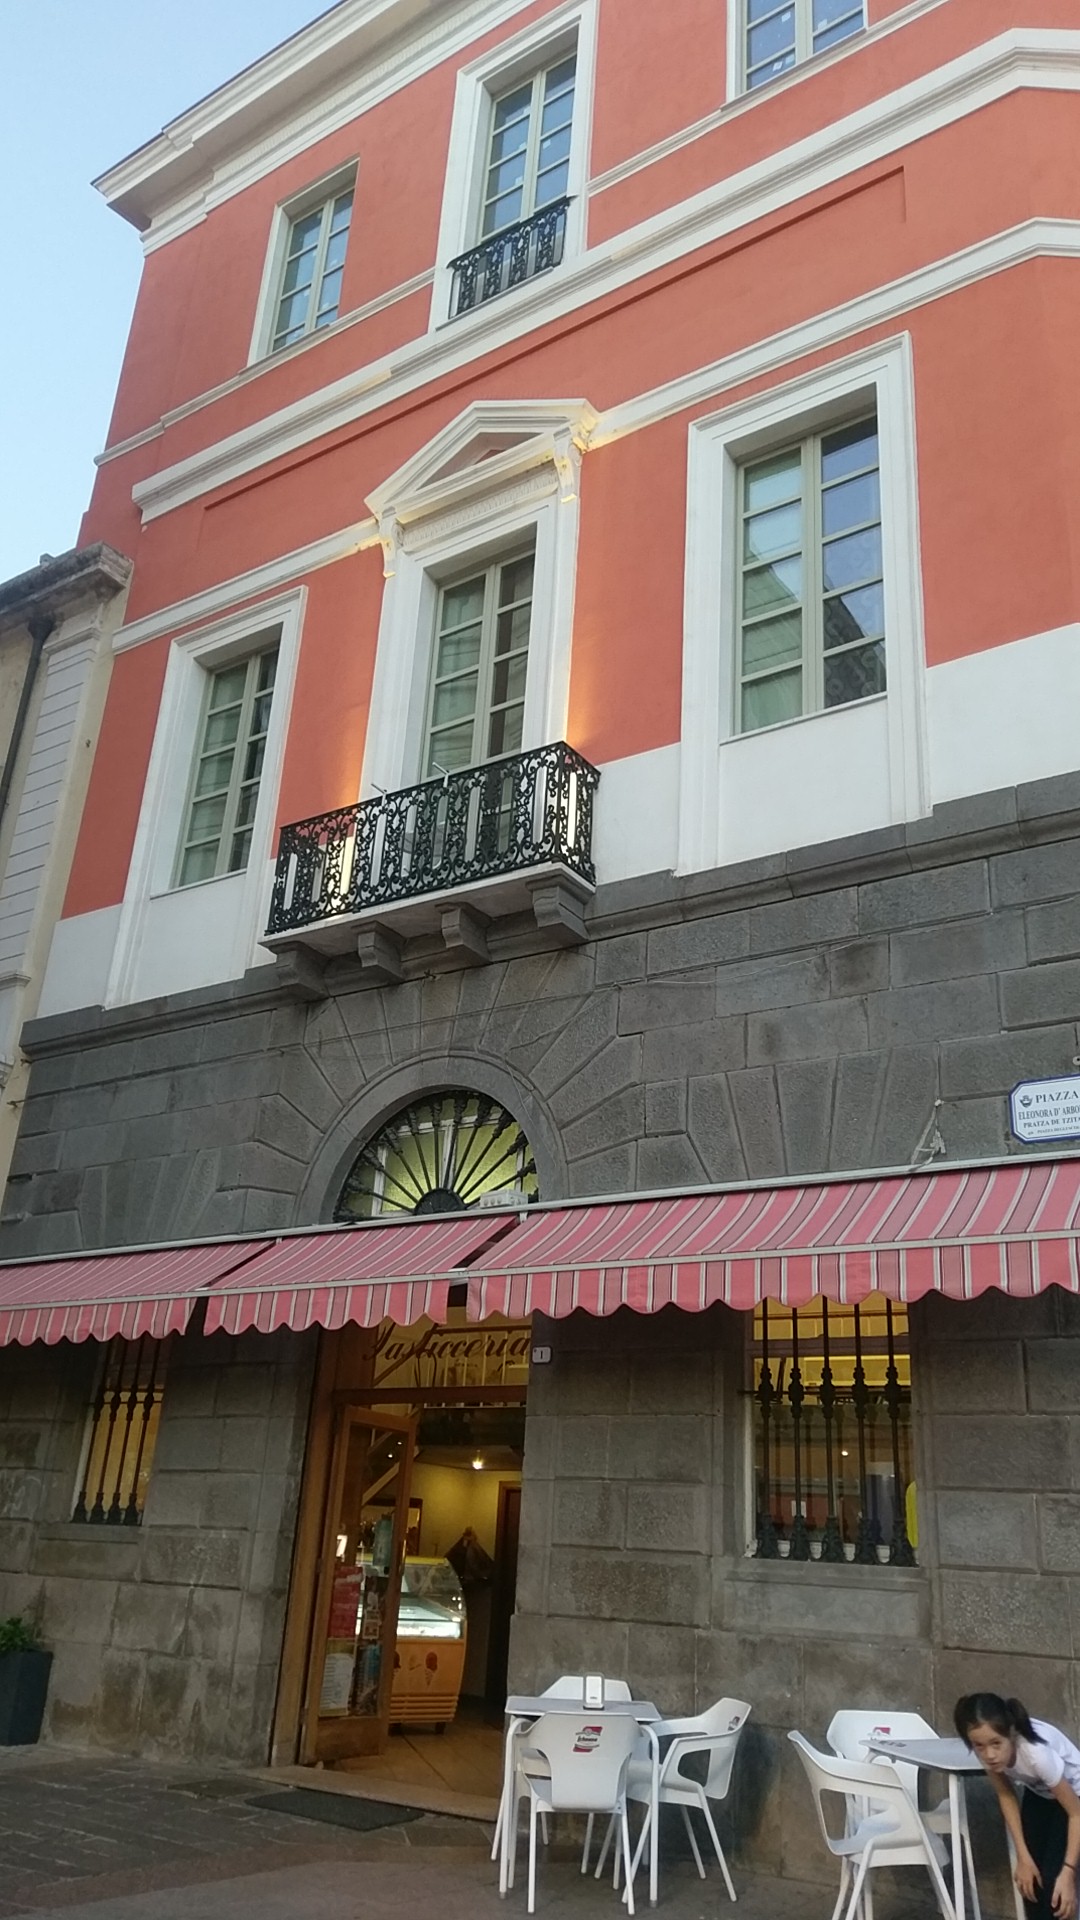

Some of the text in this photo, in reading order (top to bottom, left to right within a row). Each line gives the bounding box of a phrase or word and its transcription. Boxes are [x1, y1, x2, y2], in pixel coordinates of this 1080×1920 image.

[1035, 1090, 1079, 1103] PIAZZA
[1018, 1105, 1080, 1120] ELEONORA D' ARBO
